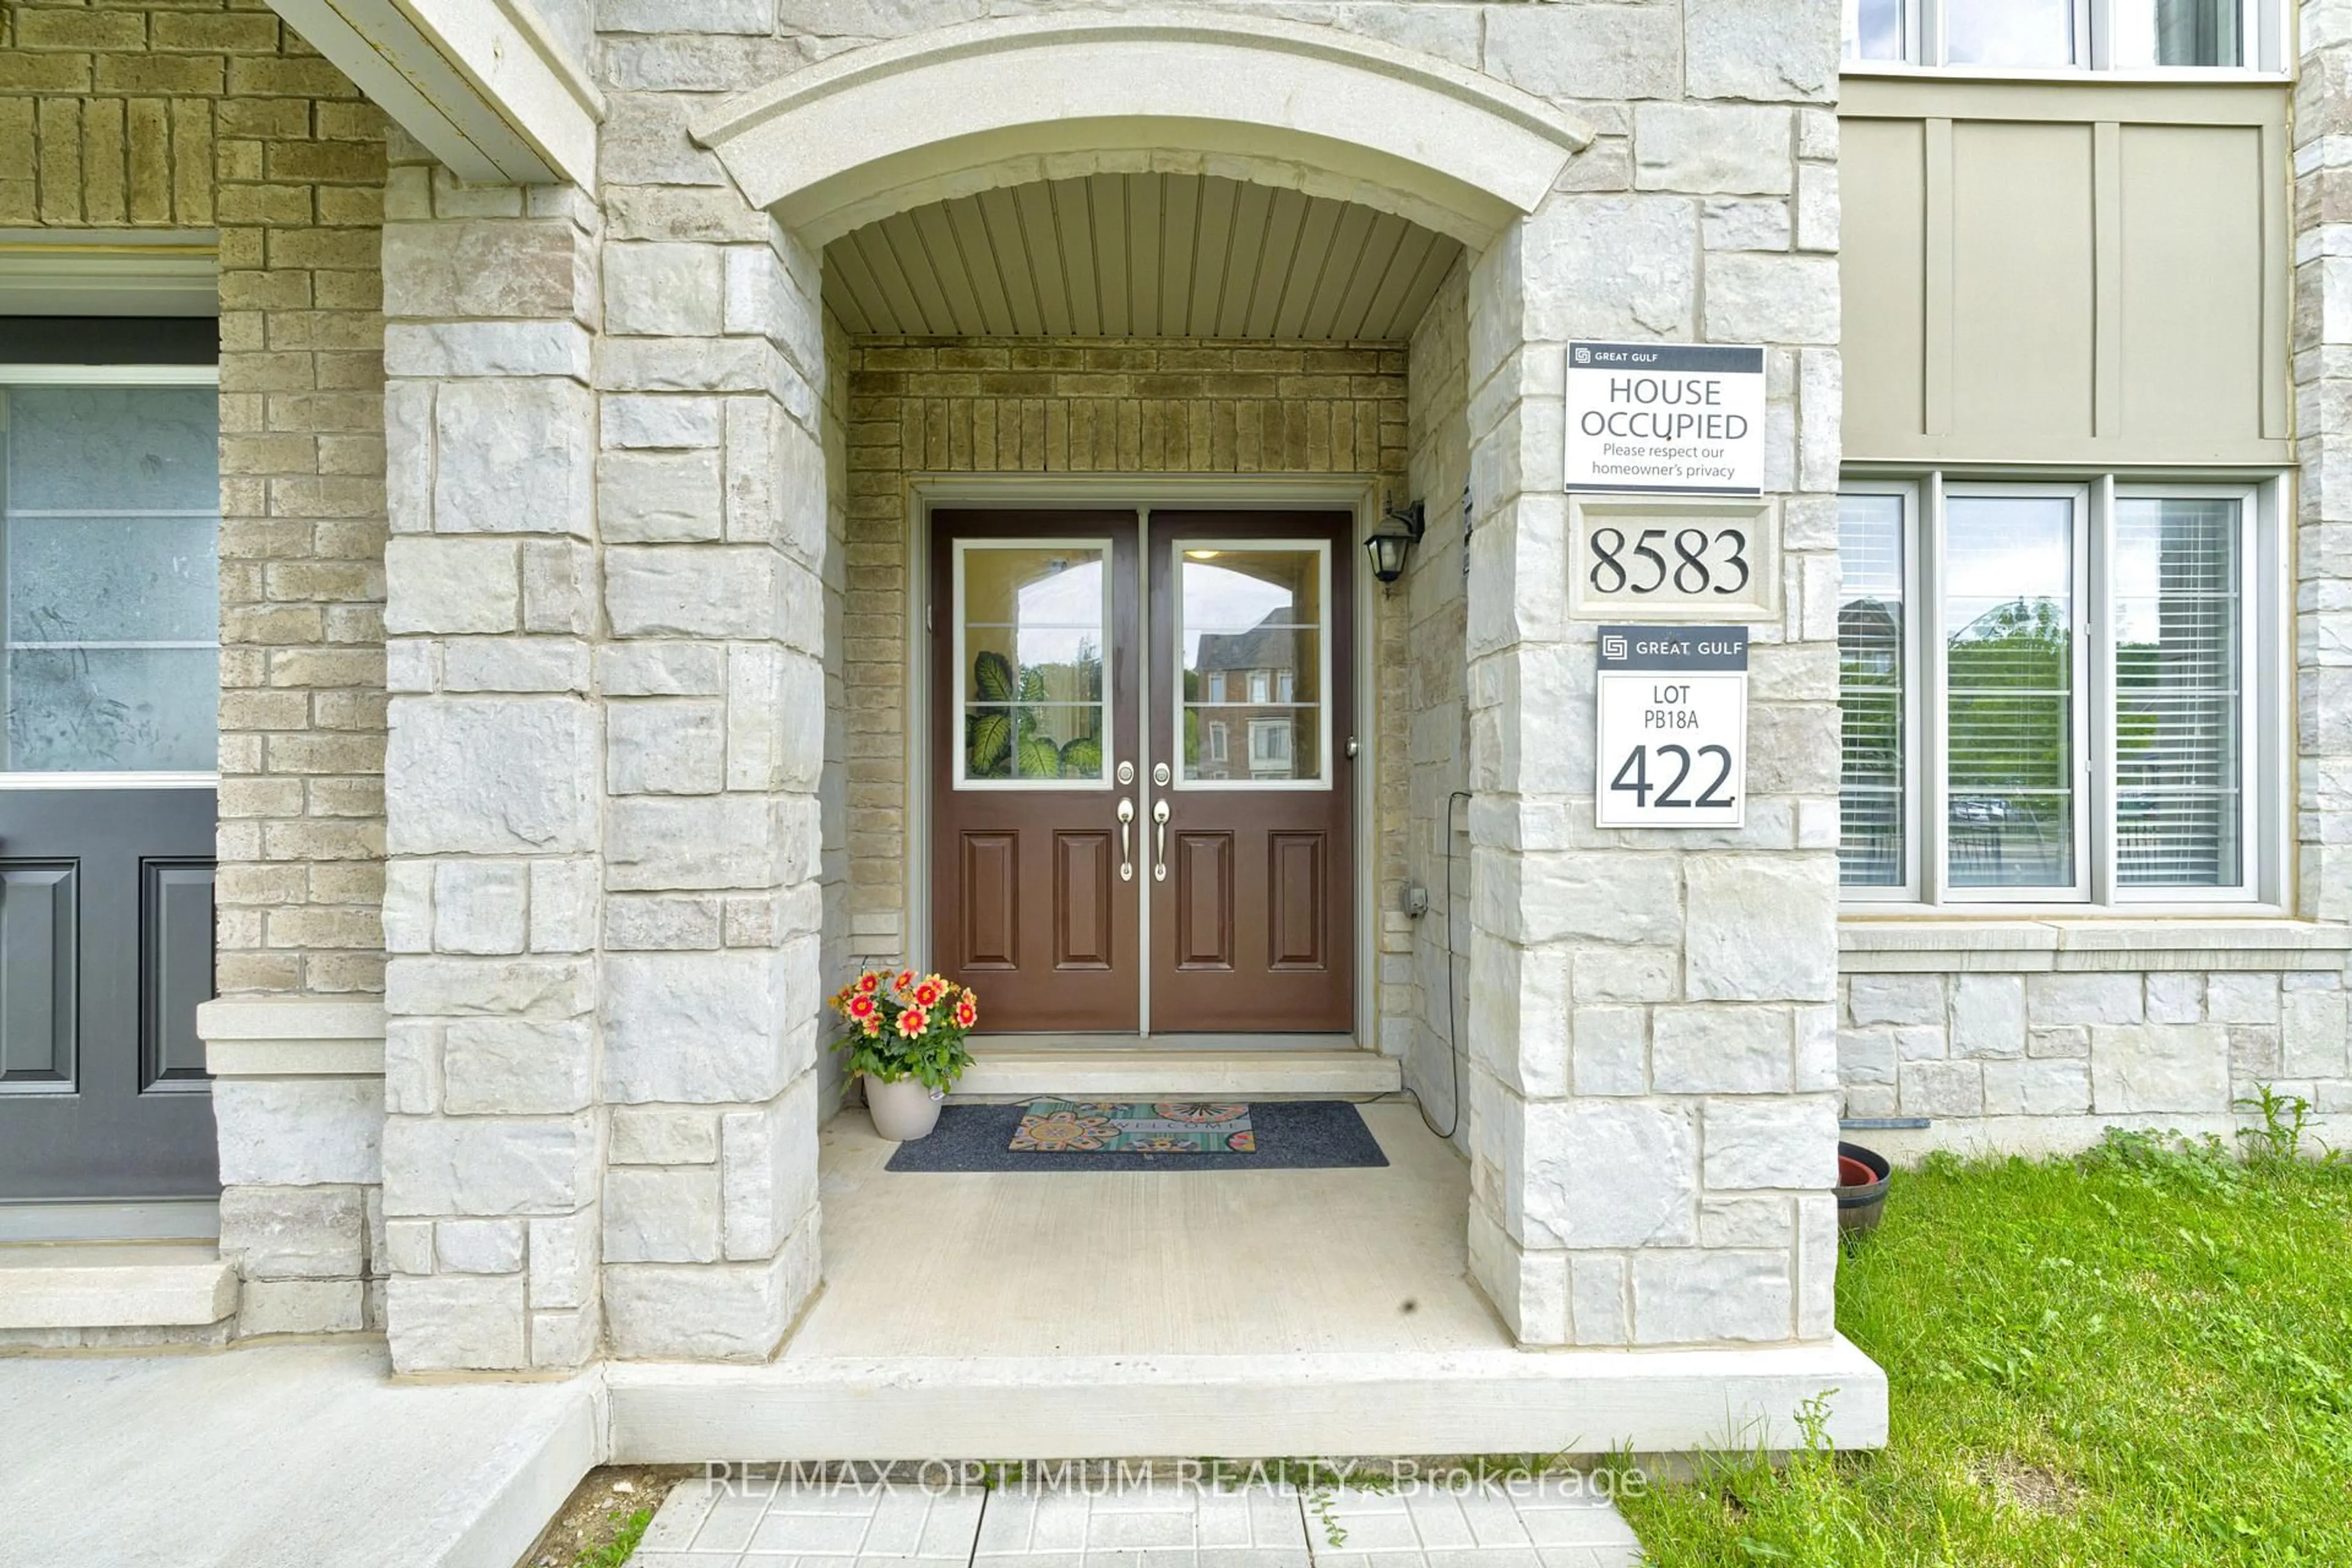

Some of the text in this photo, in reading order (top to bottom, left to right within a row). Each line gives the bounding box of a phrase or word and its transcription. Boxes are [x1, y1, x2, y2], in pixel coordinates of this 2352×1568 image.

[1595, 353, 1657, 362] GREAT GULF
[1610, 378, 1721, 405] HOUSE
[1581, 411, 1748, 439] OCCUPIED
[1604, 443, 1724, 459] Please respect our
[1686, 466, 1735, 480] privacy
[1590, 528, 1749, 594] 8583
[1636, 642, 1743, 655] GREAT GULF
[1654, 685, 1691, 704] LOT
[1645, 710, 1698, 729] PB18A
[1610, 744, 1732, 808] 422
